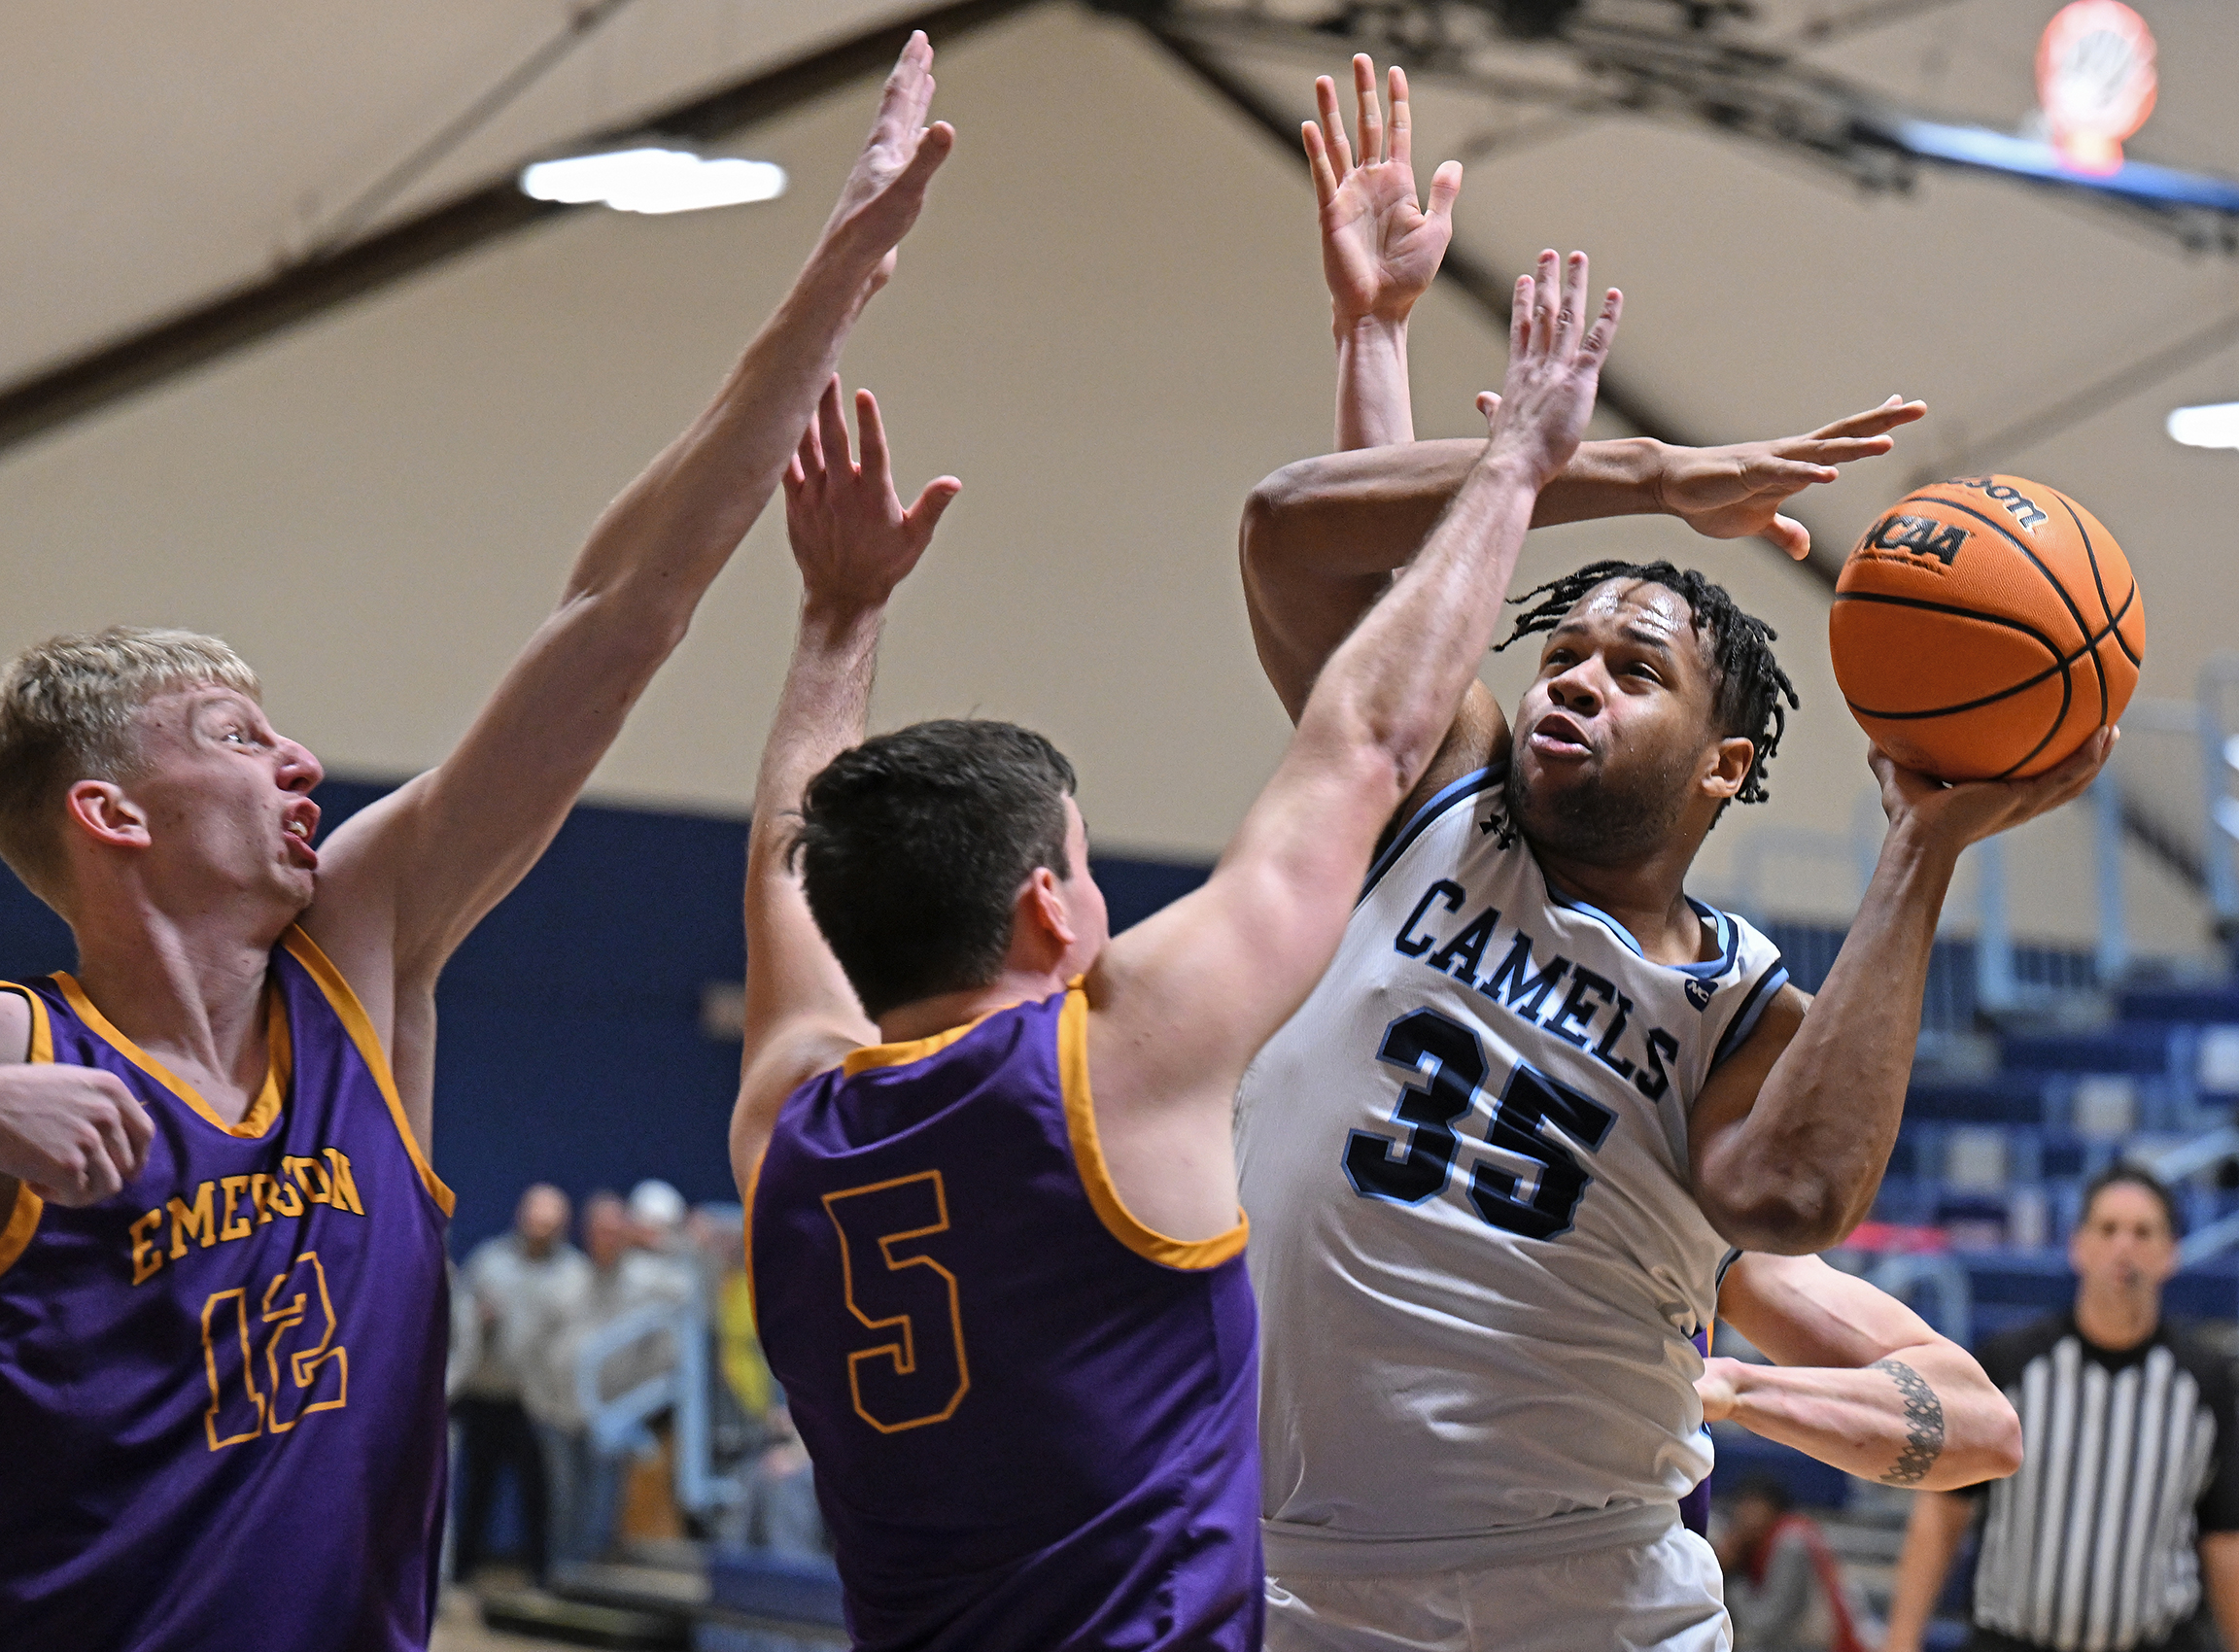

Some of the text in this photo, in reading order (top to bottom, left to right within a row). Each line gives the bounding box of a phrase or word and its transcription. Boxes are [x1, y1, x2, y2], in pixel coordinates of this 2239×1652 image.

[1394, 878, 1679, 1104] CAMELS
[128, 1147, 365, 1286] EMERSON
[1340, 1006, 1619, 1242] 35
[201, 1251, 347, 1452] 12
[821, 1169, 970, 1434] 5
